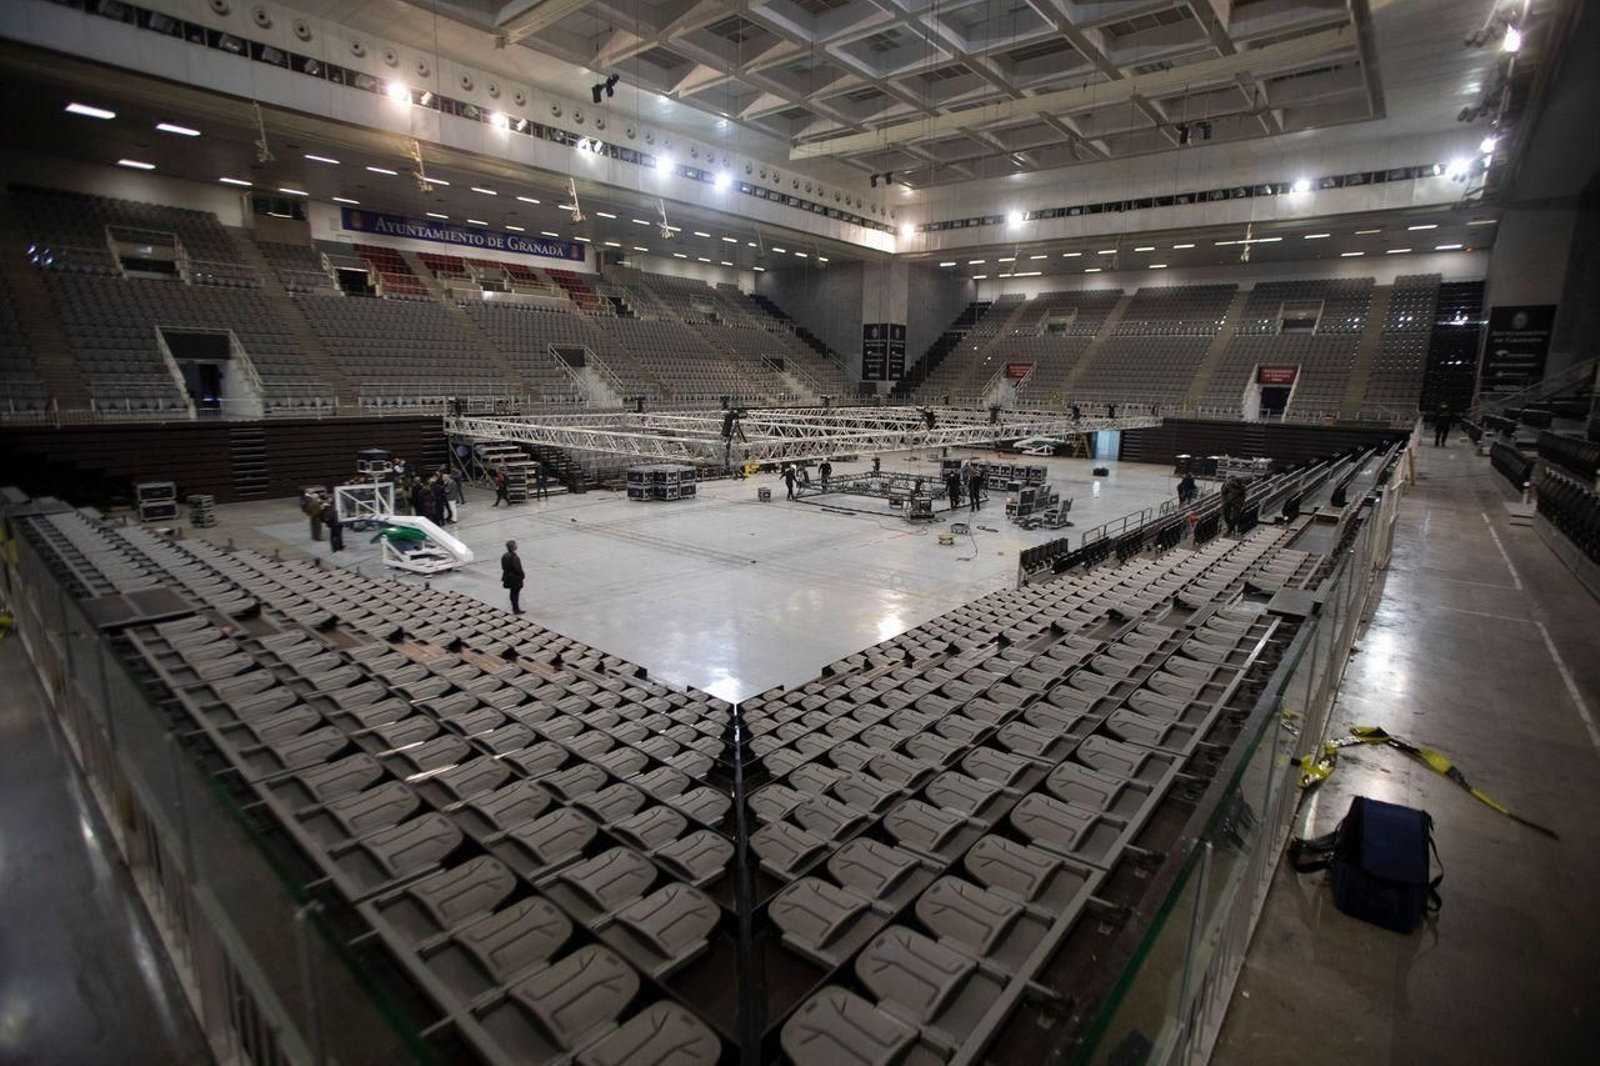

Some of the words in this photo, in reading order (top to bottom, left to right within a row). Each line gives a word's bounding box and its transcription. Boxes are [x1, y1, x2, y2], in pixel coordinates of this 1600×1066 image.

[375, 217, 484, 245] AYUNTAMIENTO
[488, 237, 504, 249] DE
[507, 237, 565, 257] GRANADA
